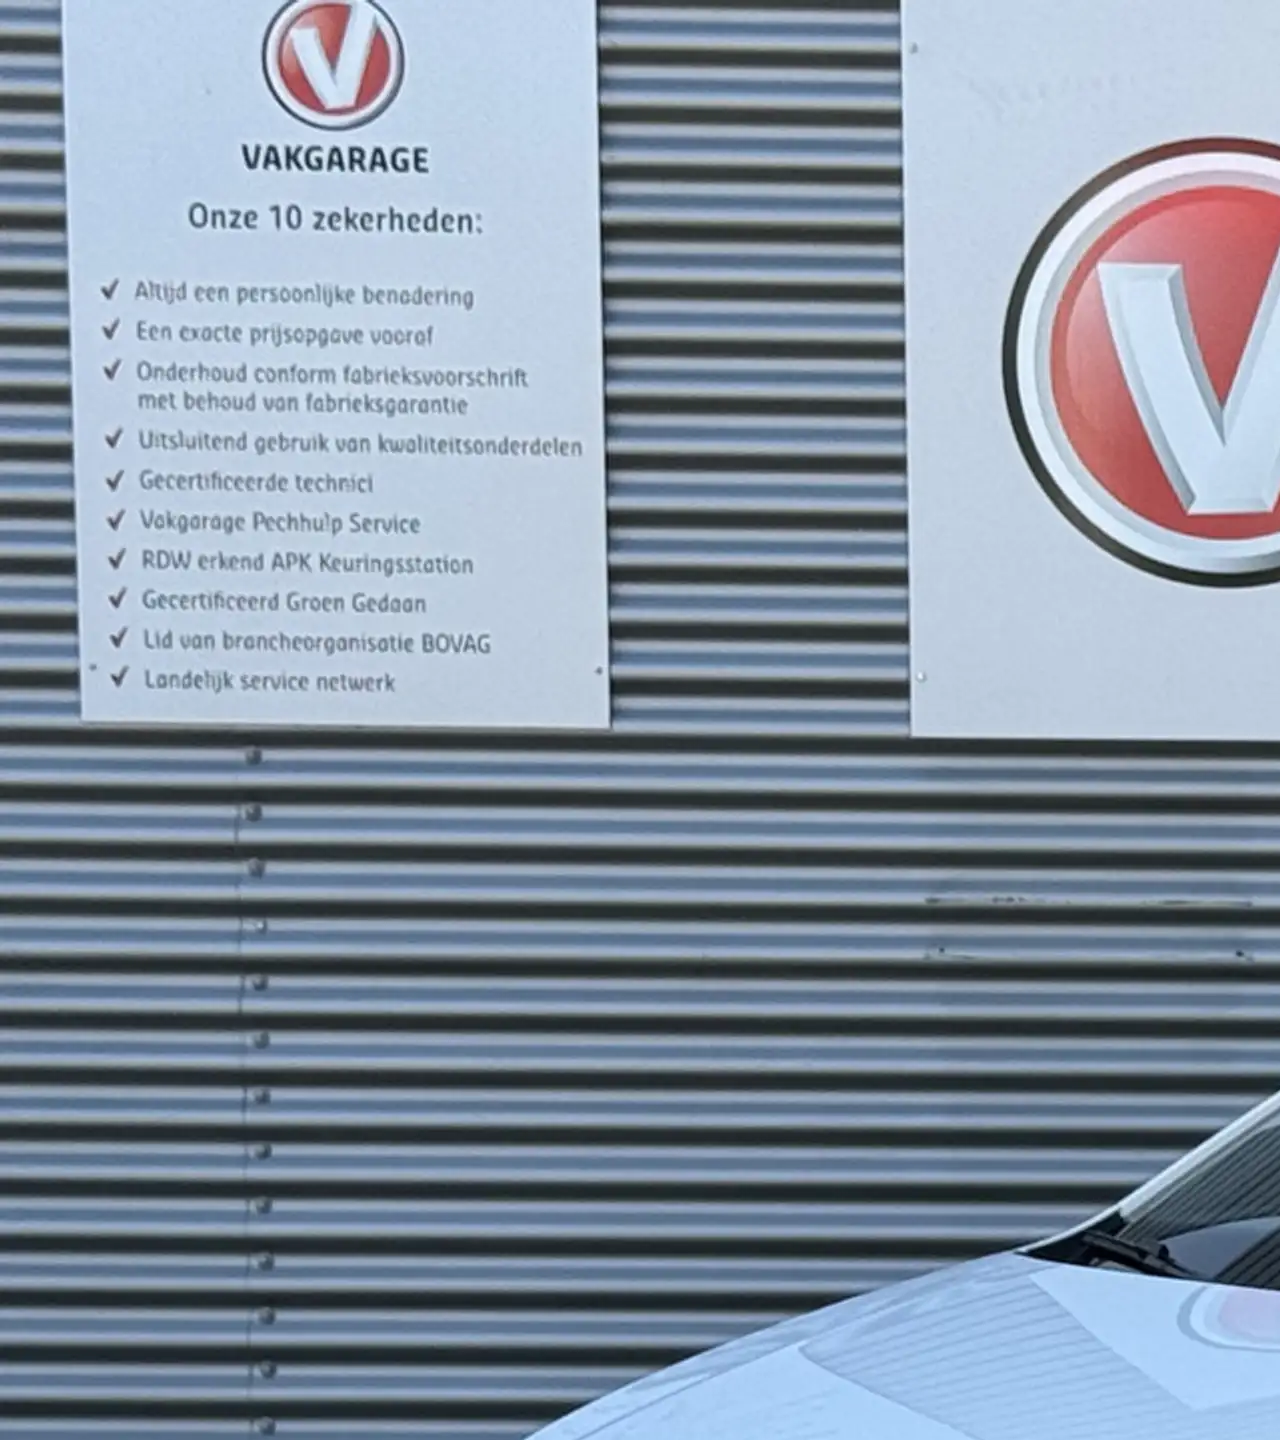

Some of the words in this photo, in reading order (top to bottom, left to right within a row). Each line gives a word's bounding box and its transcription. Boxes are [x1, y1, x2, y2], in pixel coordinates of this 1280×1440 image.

[240, 143, 430, 174] VAKGARAGE
[187, 201, 259, 231] Onze
[268, 202, 303, 232] 10
[311, 205, 483, 235] zekerheden:
[134, 280, 188, 306] Altijd
[193, 285, 230, 304] een
[235, 282, 356, 309] persoonlijke
[362, 284, 474, 311] benadering
[135, 319, 173, 342] Een
[178, 323, 243, 344] exacte
[249, 322, 364, 348] prijsopgave
[370, 324, 434, 347] vooraf
[136, 359, 248, 384] Onderhoud
[253, 363, 337, 385] conform
[342, 363, 529, 388] fabrieksvoorschrift
[137, 391, 178, 411] met
[182, 389, 257, 412] behoud
[262, 395, 300, 414] van
[305, 391, 469, 419] fabrieksgarantie
[138, 428, 248, 452] Uitsluitend
[253, 431, 332, 457] gebruik
[334, 437, 372, 455] van
[377, 432, 583, 457] kwaliteitsonderdelen
[138, 468, 289, 494] Gecertificeerde
[294, 472, 374, 494] technici
[138, 508, 246, 536] Vakgarage
[252, 510, 343, 538] Pechhulp
[349, 512, 421, 535] Service
[141, 548, 192, 571] RDW
[197, 550, 265, 572] erkend
[270, 551, 313, 574] APK
[318, 551, 474, 579] Keuringsstation
[141, 587, 280, 612] Gecertificeerd
[285, 590, 346, 614] Groen
[351, 591, 427, 614] Gedaan
[143, 628, 174, 650] Lid
[179, 633, 216, 652] van
[222, 629, 415, 657] brancheorganisatie
[421, 632, 491, 655] BOVAG
[143, 668, 234, 695] Landelijk
[239, 671, 310, 692] service
[315, 672, 396, 693] netwerk
